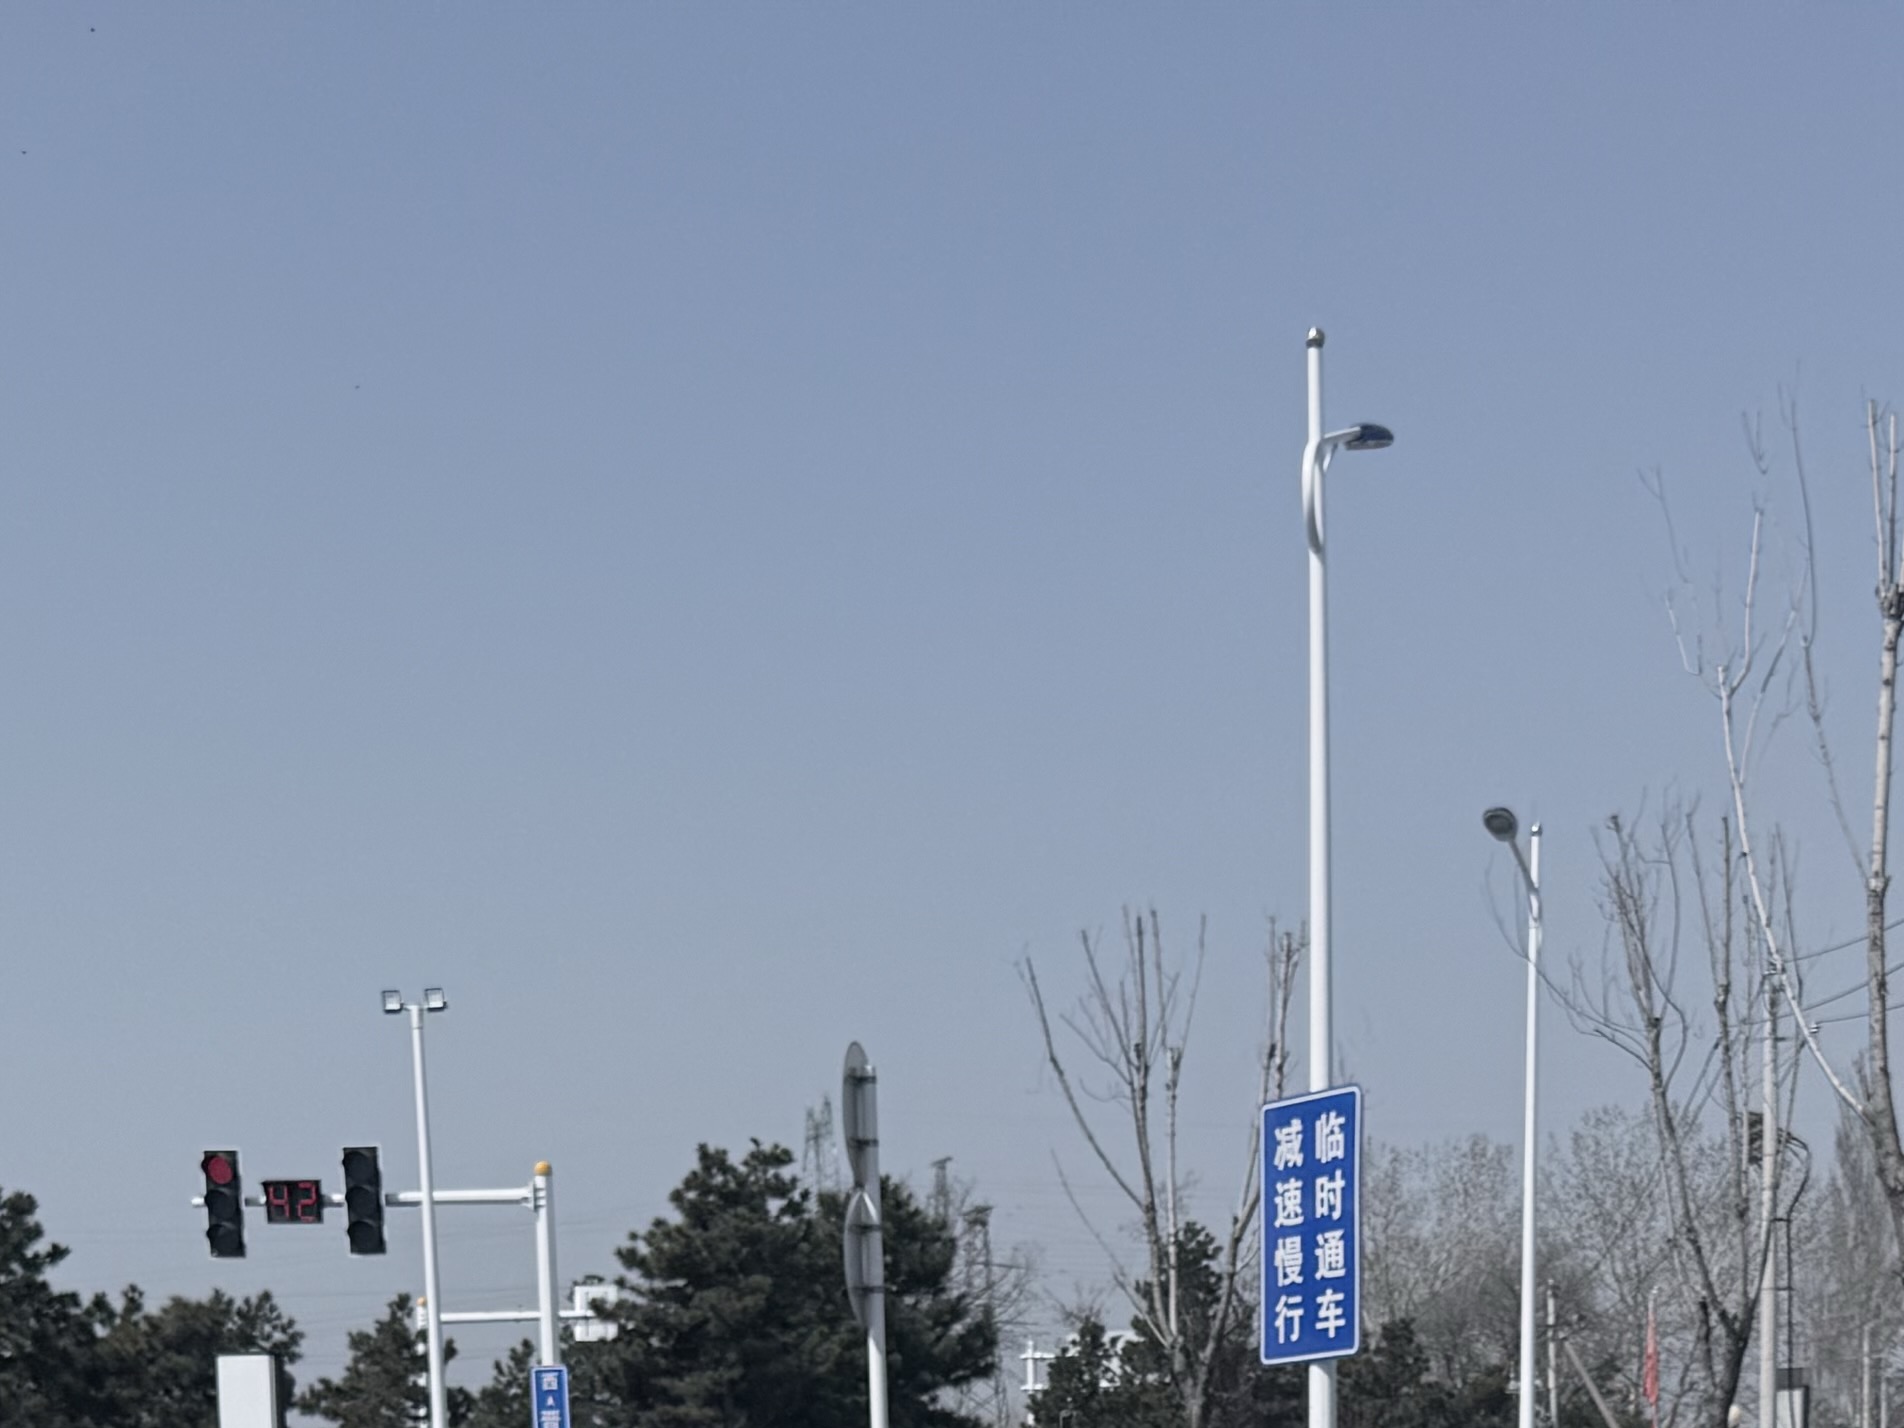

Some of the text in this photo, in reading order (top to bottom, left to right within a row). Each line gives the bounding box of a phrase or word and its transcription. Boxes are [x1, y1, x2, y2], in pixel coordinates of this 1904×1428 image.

[269, 1182, 317, 1223] 42
[1273, 1118, 1304, 1344] 减速慢行
[1315, 1111, 1346, 1338] 临时通车
